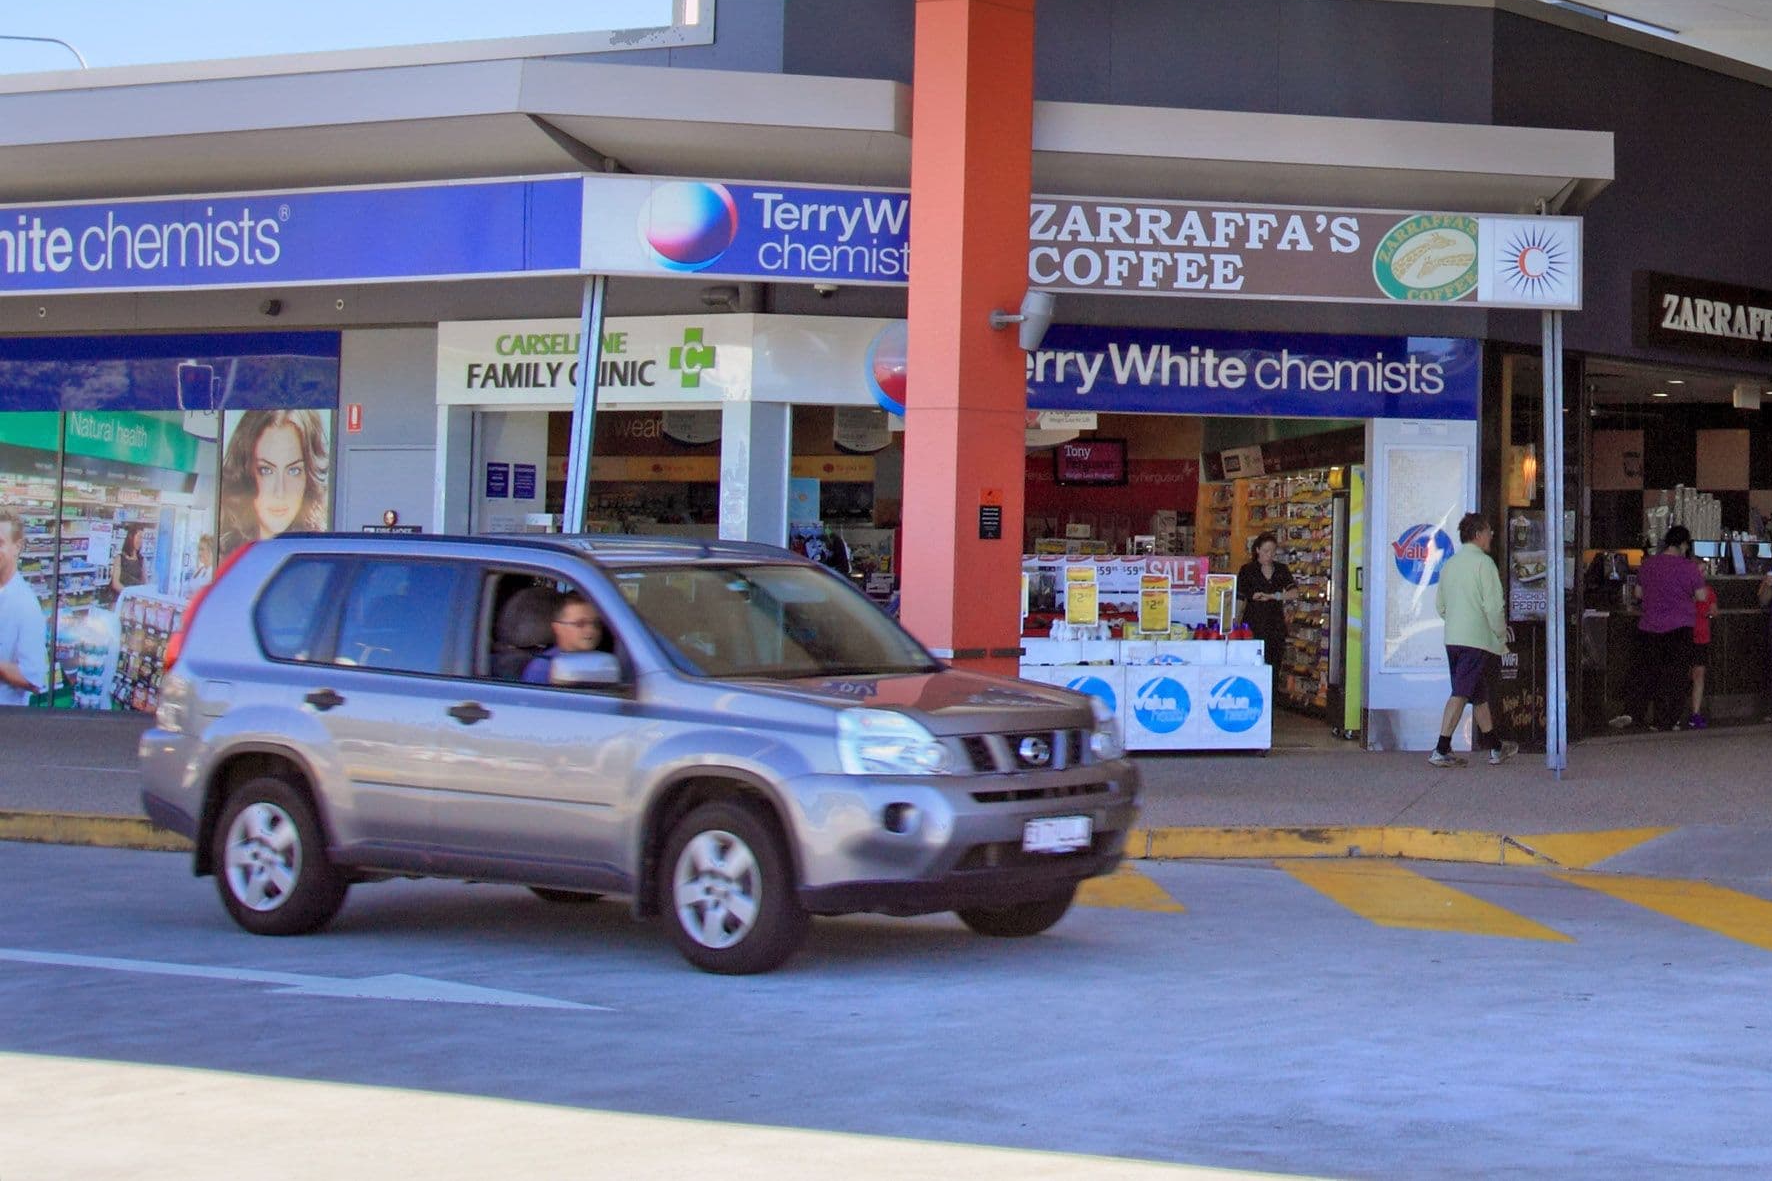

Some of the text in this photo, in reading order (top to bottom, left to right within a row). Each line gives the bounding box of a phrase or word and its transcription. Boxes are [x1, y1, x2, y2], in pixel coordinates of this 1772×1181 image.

[1030, 203, 1361, 253] ZARRAFFA'S
[1028, 247, 1244, 290] COFFEE
[495, 332, 629, 356] CARSELNE
[467, 360, 657, 389] FAMILY INIC
[1256, 352, 1445, 394] chemists
[71, 410, 148, 449] Natural health
[1063, 444, 1092, 460] Tony
[1149, 560, 1197, 586] SALE
